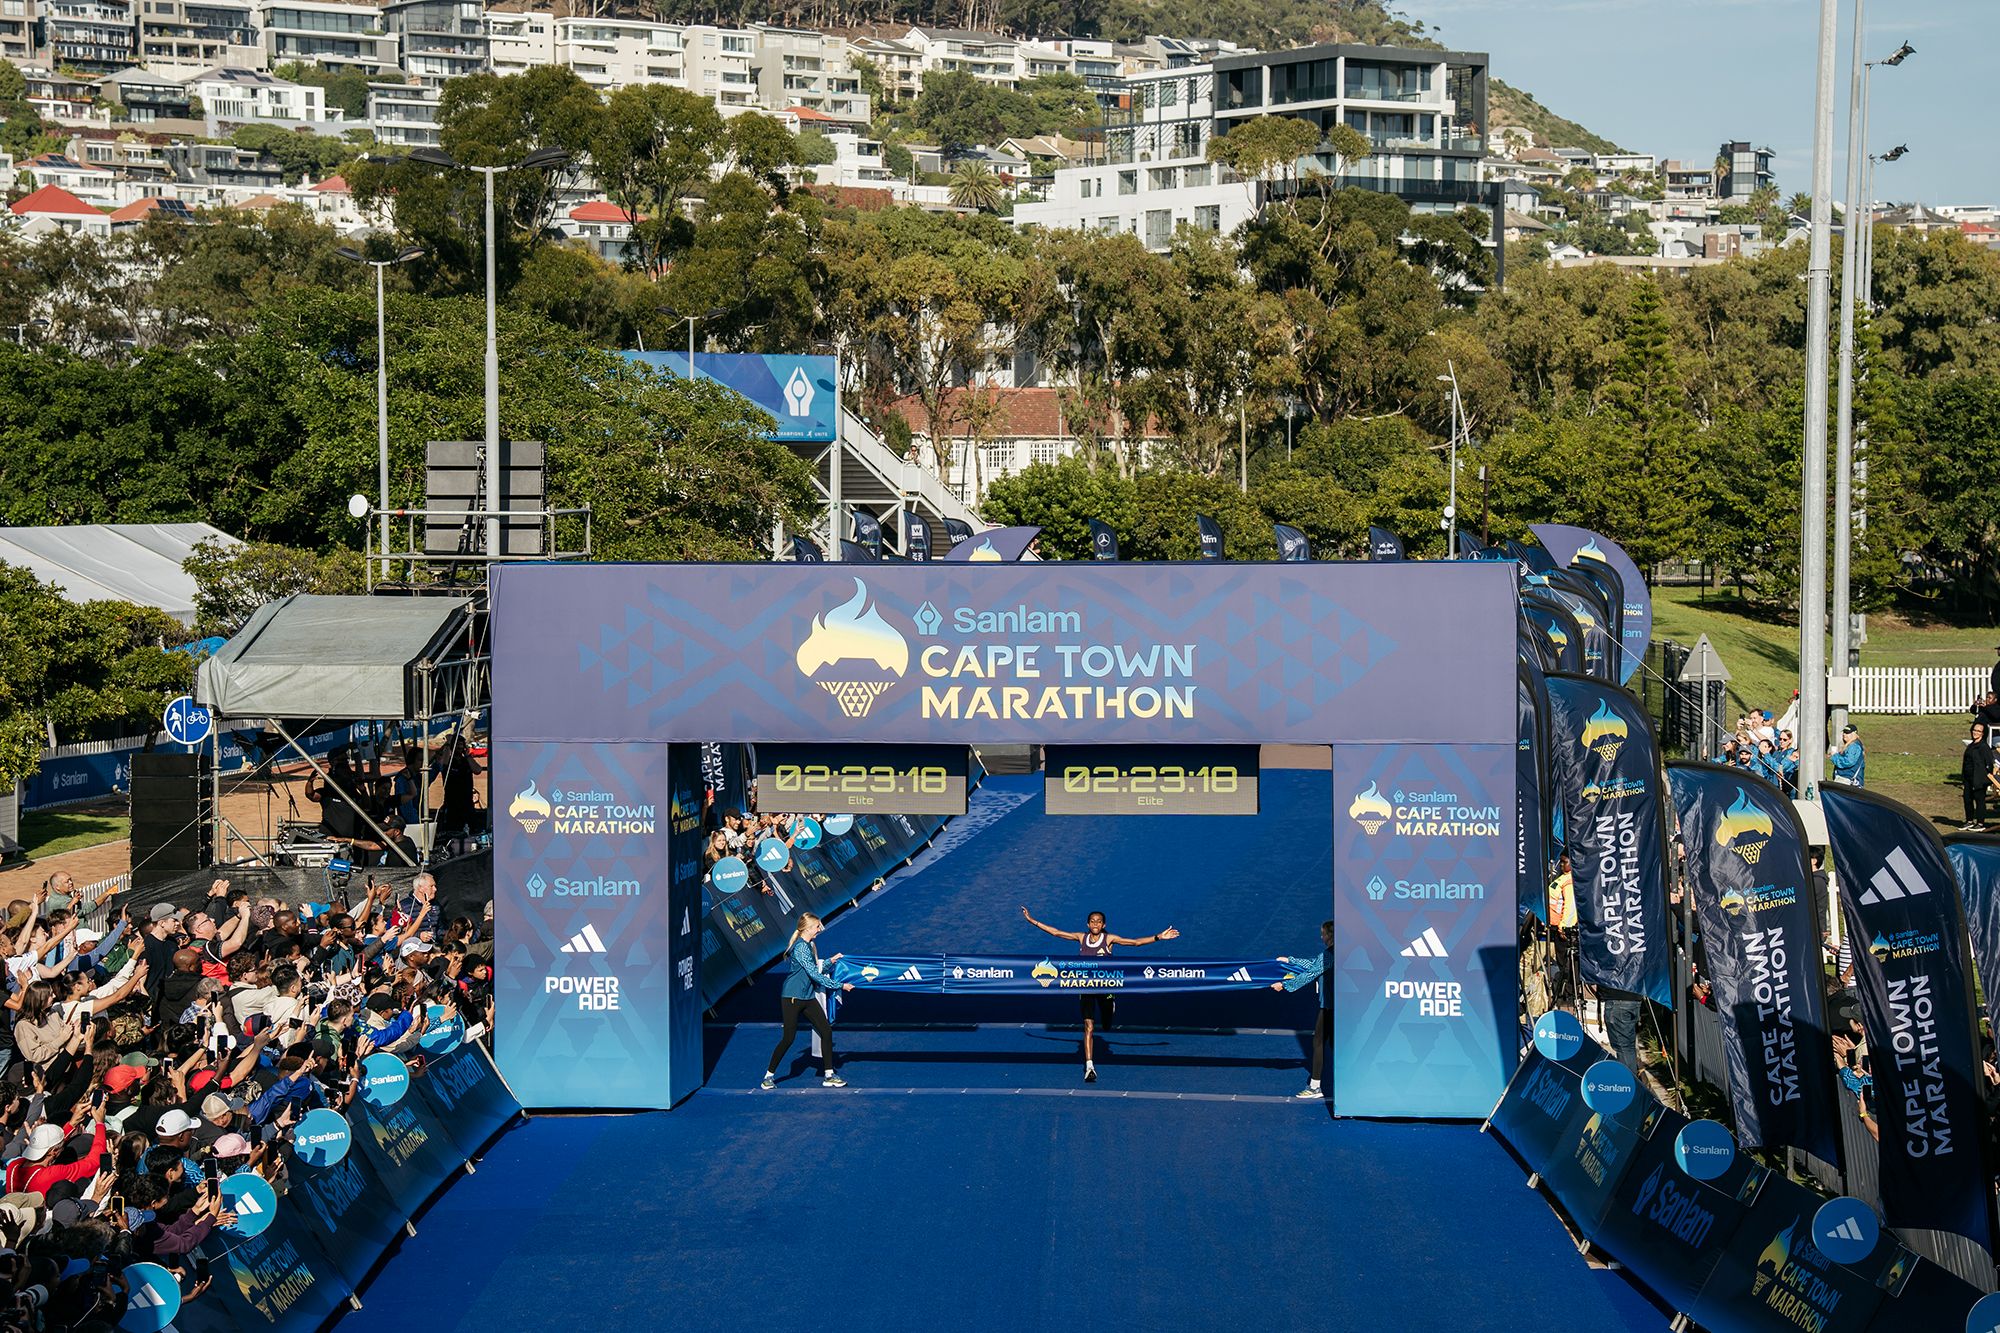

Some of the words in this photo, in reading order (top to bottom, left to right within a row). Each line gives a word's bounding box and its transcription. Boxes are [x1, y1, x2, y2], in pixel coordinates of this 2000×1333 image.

[951, 533, 968, 544] kfm
[1201, 533, 1217, 543] kfm
[953, 604, 1081, 634] Sanlam
[921, 644, 1041, 678] CAPE
[1054, 644, 1198, 678] TOWN
[921, 685, 1198, 719] MARATHON
[61, 771, 89, 787] Sanlam
[775, 764, 947, 793] 02:23:18
[1064, 765, 1238, 793] 02:23:18
[1601, 783, 1621, 794] CAPE
[1623, 779, 1644, 790] TOWN
[566, 790, 614, 802] Sanlam
[848, 795, 874, 805] Elite
[1137, 796, 1164, 806] Elite
[1408, 790, 1458, 803] Sanlam
[1602, 786, 1645, 800] MARATHON
[554, 805, 599, 819] CAPE
[604, 805, 656, 818] TOWN
[1396, 806, 1442, 820] CAPE
[1447, 806, 1500, 820] TOWN
[554, 820, 656, 834] MARATHON
[1396, 822, 1500, 836] MARATHON
[1595, 815, 1619, 887] TOWN
[722, 869, 746, 880] Sanlam
[1617, 811, 1647, 954] MARATHON
[553, 876, 640, 896] Sanlam
[1393, 878, 1484, 899] Sanlam
[1751, 883, 1775, 895] Sanlam
[1746, 892, 1770, 904] CAPE
[1772, 886, 1795, 898] TOWN
[1747, 895, 1796, 913] MARATHON
[1602, 892, 1626, 955] CAPE
[1891, 939, 1914, 950] CAPE
[1915, 932, 1939, 945] TOWN
[1895, 929, 1919, 938] Sanlam
[1892, 942, 1940, 959] MARATHON
[966, 967, 1014, 978] Sanlam
[1060, 970, 1089, 979] CAPE
[1091, 970, 1124, 978] TOWN
[1158, 967, 1206, 978] Sanlam
[1742, 931, 1774, 1022] TOWN
[545, 976, 619, 993] POWER
[1060, 979, 1124, 987] MARATHON
[1385, 981, 1462, 999] POWER
[578, 993, 621, 1010] ADE
[1419, 999, 1464, 1017] ADE
[1767, 927, 1801, 1102] MARATHON
[1887, 979, 1916, 1072] TOWN
[1548, 1030, 1579, 1042] Sanlam
[1762, 1028, 1783, 1106] CAPE
[1910, 974, 1953, 1156] MARATHON
[371, 1074, 405, 1085] Sanlam
[440, 1053, 486, 1099] Sanlam
[1531, 1068, 1572, 1121] Sanlam
[1598, 1083, 1631, 1093] Sanlam
[1903, 1078, 1929, 1158] CAPE
[308, 1131, 345, 1144] Sanlam
[1692, 1145, 1730, 1156] Sanlam
[1650, 1179, 1715, 1249] Sanlam
[254, 1260, 281, 1289] CAPE
[275, 1238, 300, 1270] TOWN
[269, 1262, 316, 1314] MARATHON
[1780, 1261, 1812, 1292] CAPE
[1806, 1278, 1843, 1314] TOWN
[1765, 1284, 1829, 1333] MARATHON
